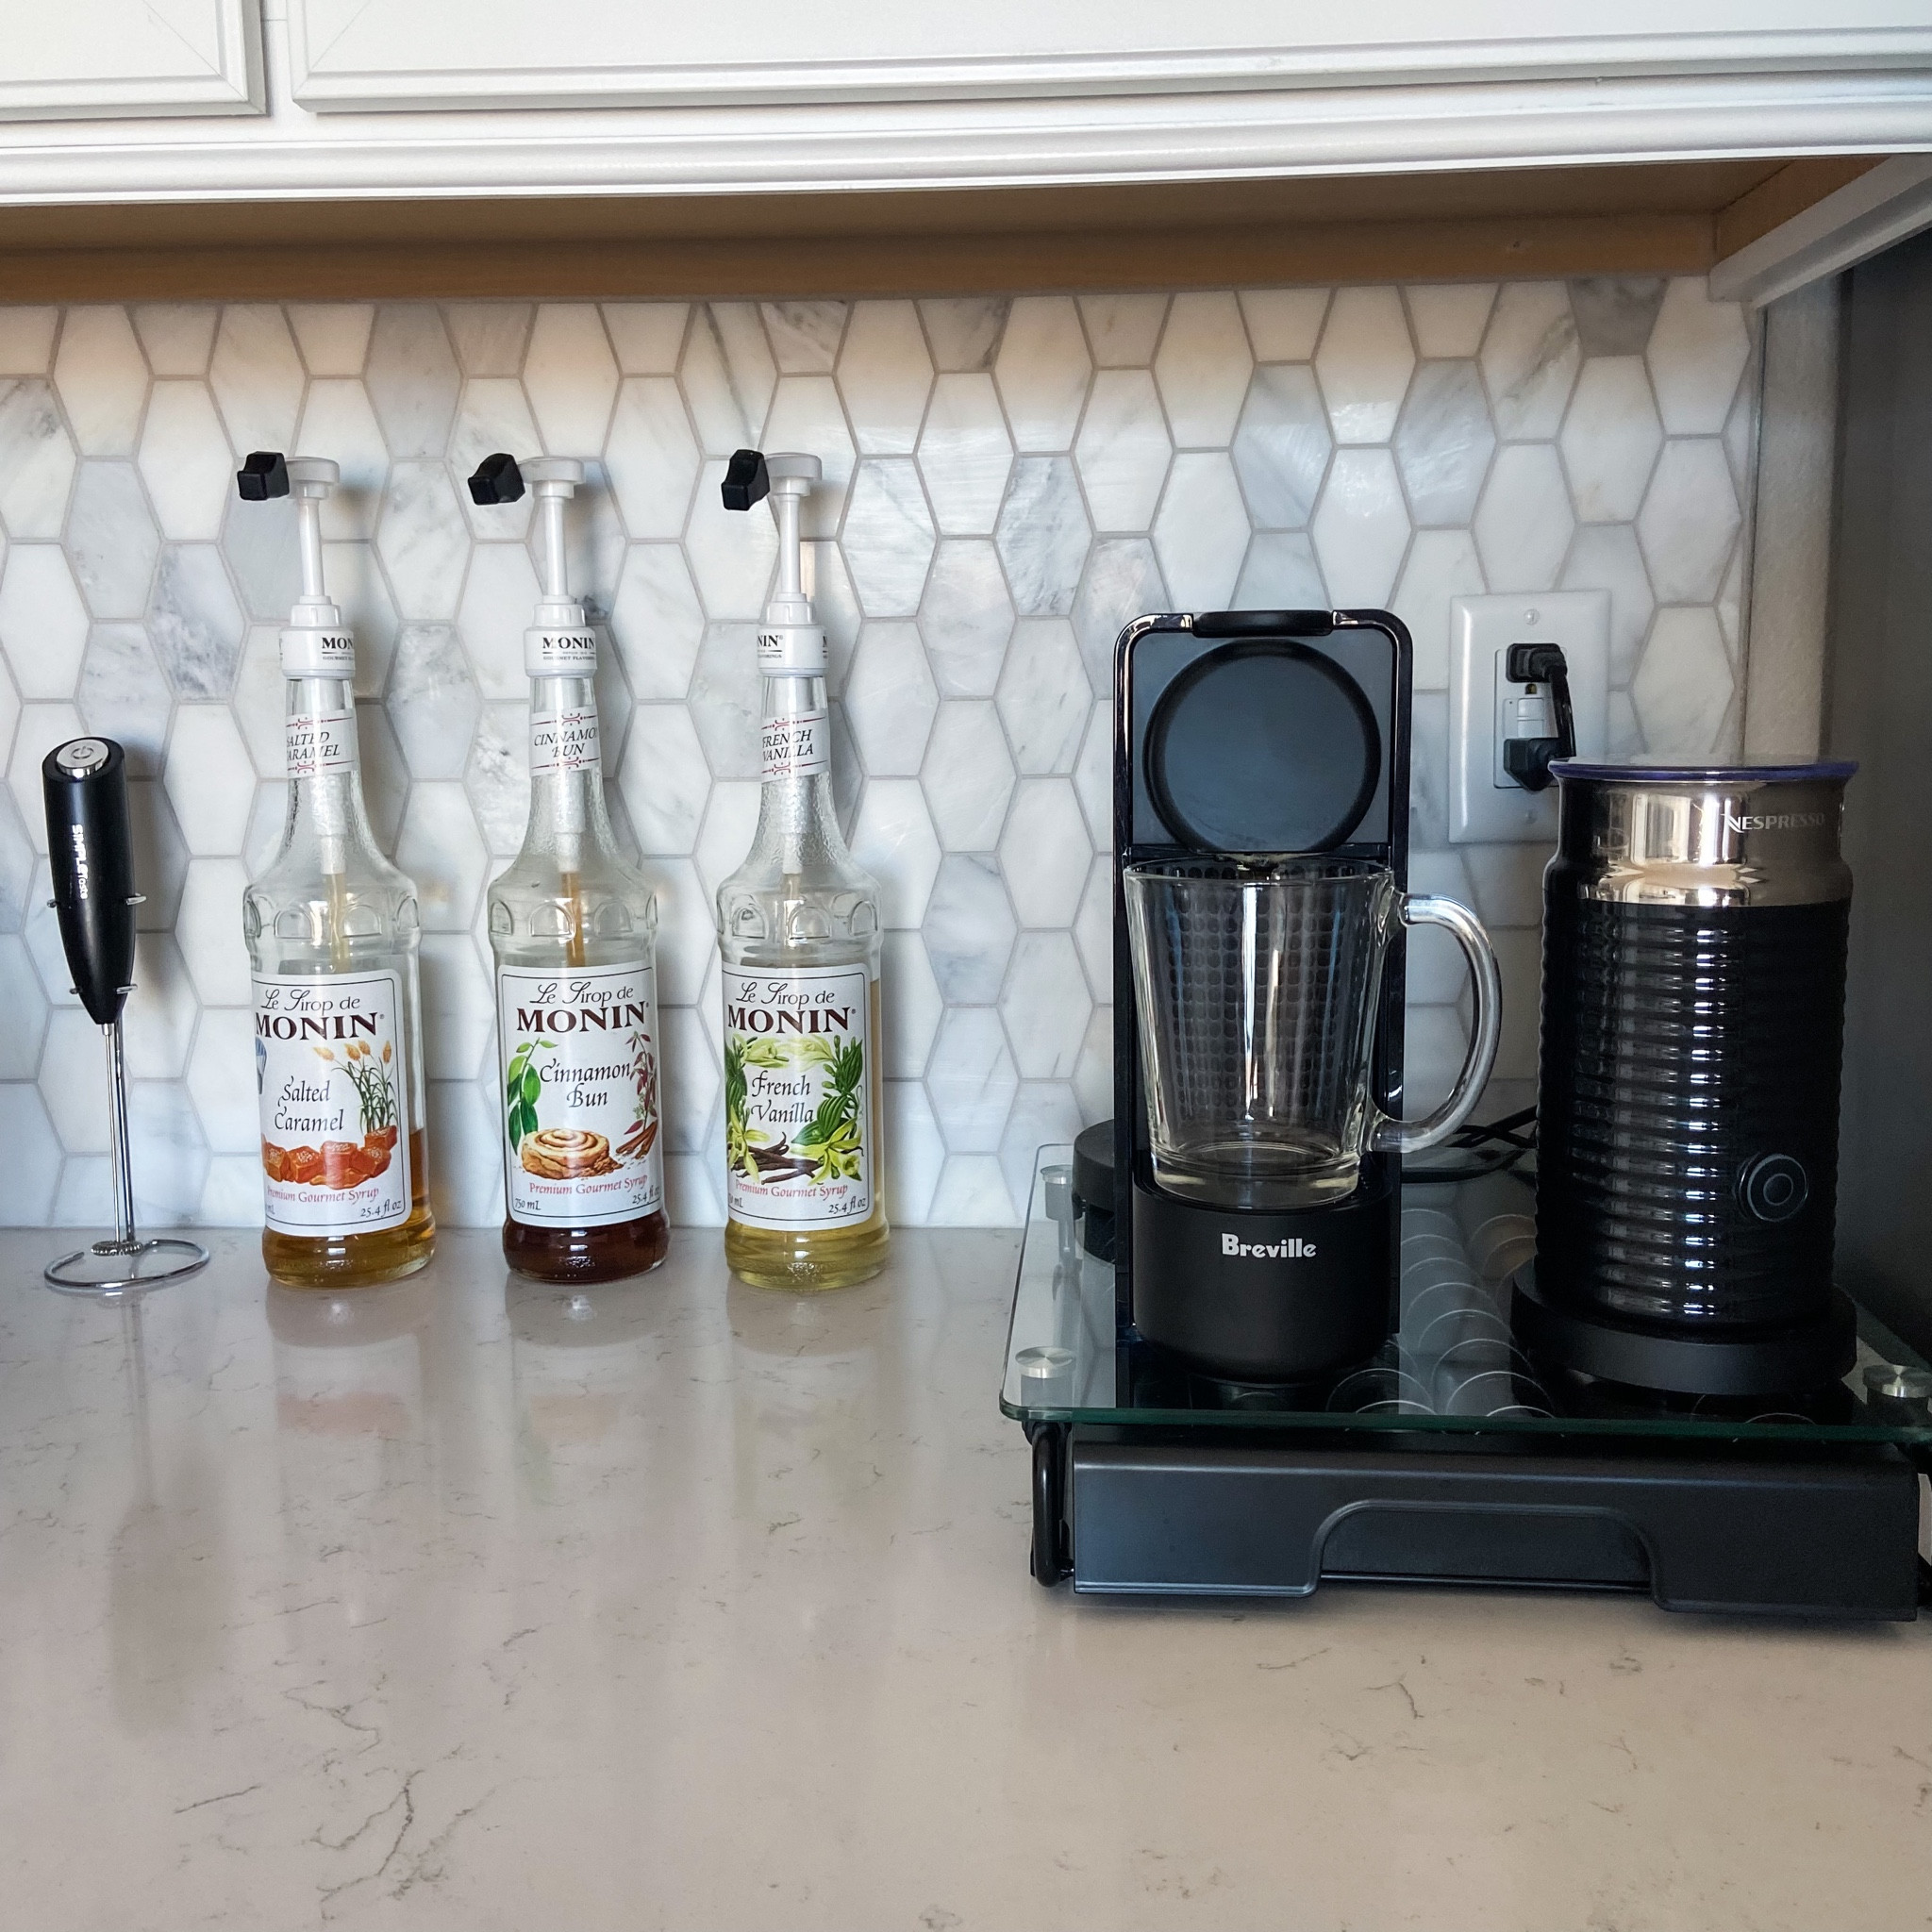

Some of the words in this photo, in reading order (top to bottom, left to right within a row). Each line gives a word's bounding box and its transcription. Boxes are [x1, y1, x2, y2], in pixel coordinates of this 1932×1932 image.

[322, 637, 354, 650] MON
[758, 635, 779, 648] NIN
[534, 727, 597, 746] CINNAMO
[762, 728, 813, 749] FRENCH
[1720, 812, 1824, 833] NESPRESSO
[260, 989, 280, 1009] Le
[284, 989, 333, 1016] Sirop
[340, 996, 360, 1009] de
[529, 982, 558, 1005] Le
[562, 981, 612, 1008] Sirop
[617, 986, 634, 999] de
[736, 981, 758, 1003] Le
[761, 982, 809, 1010] Sirop
[815, 991, 835, 1004] de
[256, 1012, 378, 1041] MONIN
[516, 1001, 646, 1033] MONIN
[728, 1005, 851, 1034] MONIN
[540, 1058, 630, 1083] Cinnamon
[278, 1075, 330, 1106] Salted
[566, 1082, 608, 1108] Bun
[751, 1070, 811, 1097] French
[274, 1106, 344, 1131] Caramel
[750, 1099, 816, 1124] Vanilla
[267, 1185, 295, 1202] Premium
[298, 1191, 345, 1203] Gourmet
[348, 1188, 379, 1205] Syrup
[529, 1182, 573, 1195] Premium
[575, 1179, 623, 1194] Gourmet
[624, 1174, 648, 1192] Syrup
[735, 1179, 769, 1196] Premium
[771, 1186, 817, 1198] Gourmet
[819, 1182, 848, 1201] Syrup
[360, 1205, 381, 1218] 25.4
[391, 1199, 402, 1209] oz
[526, 1200, 541, 1211] mL
[828, 1202, 847, 1214] 25.4
[857, 1197, 866, 1208] oz
[1221, 1232, 1317, 1258] Breville
